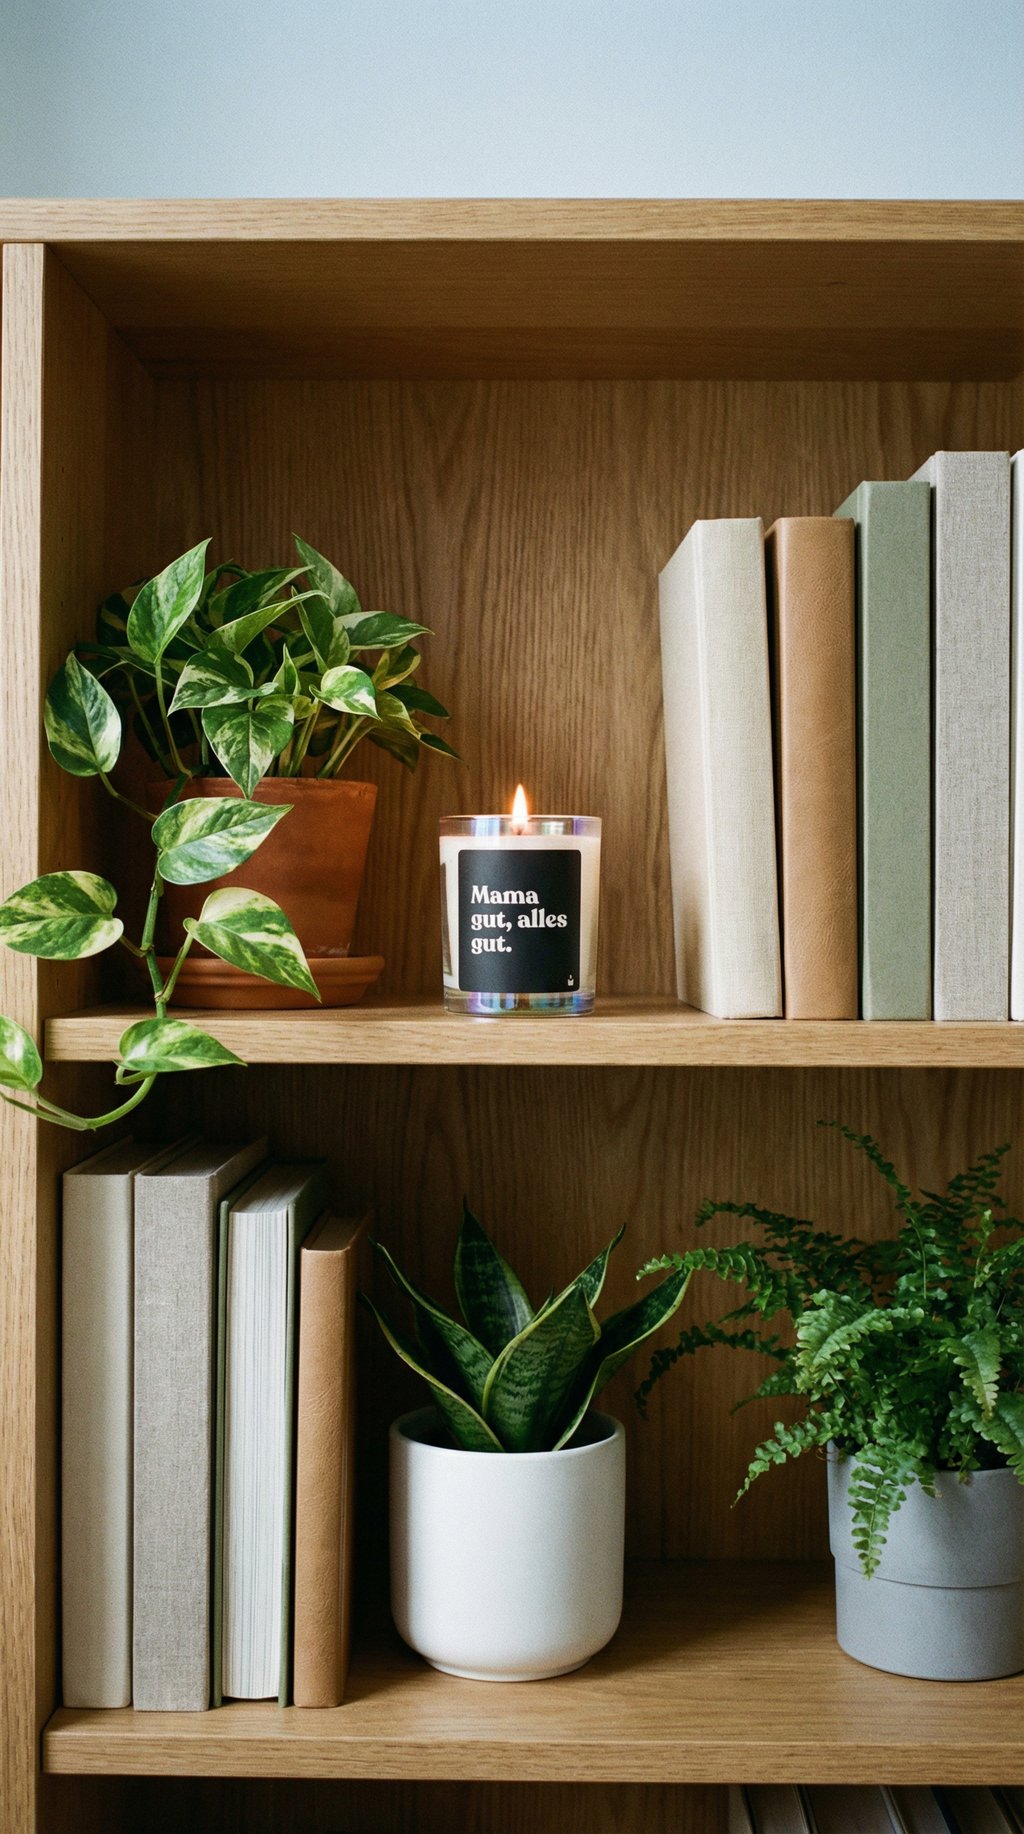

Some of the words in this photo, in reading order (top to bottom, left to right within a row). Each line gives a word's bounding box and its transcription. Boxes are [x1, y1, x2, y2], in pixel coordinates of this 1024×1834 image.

[471, 885, 539, 904] Mama
[471, 911, 512, 932] gut,
[517, 908, 568, 928] alles
[471, 936, 512, 955] gut.
